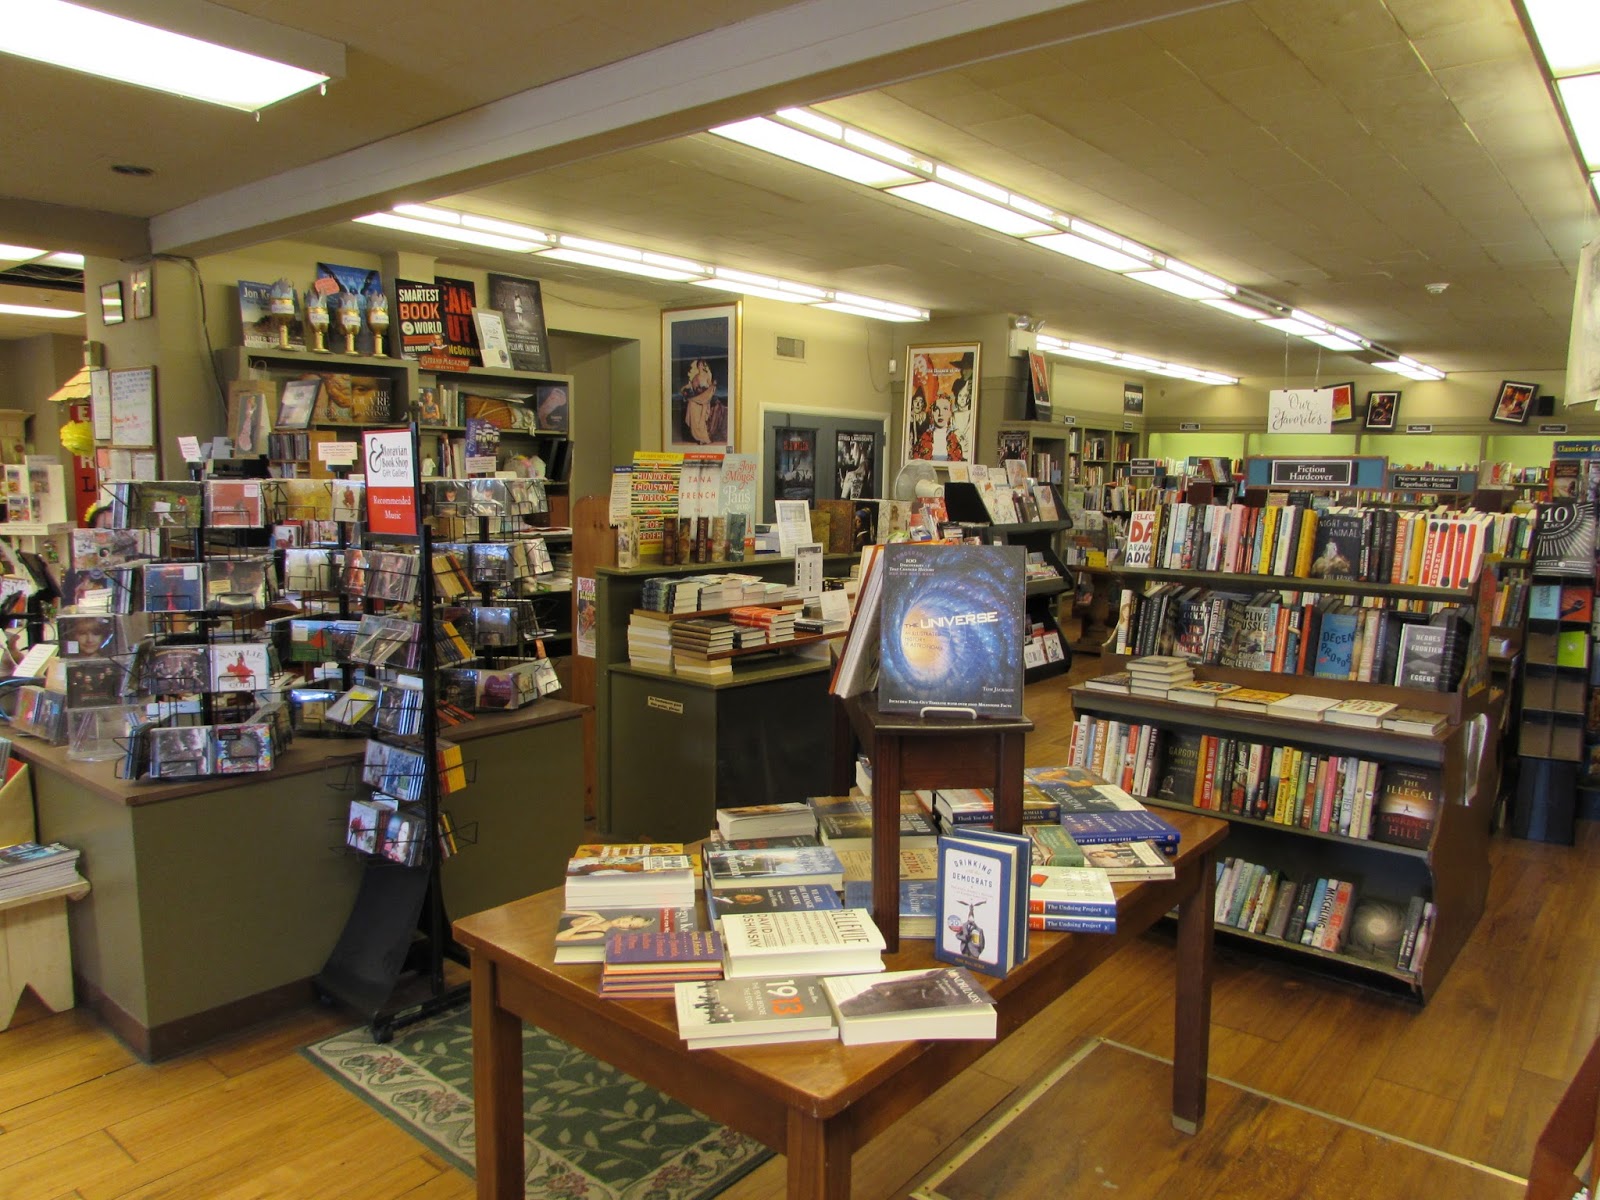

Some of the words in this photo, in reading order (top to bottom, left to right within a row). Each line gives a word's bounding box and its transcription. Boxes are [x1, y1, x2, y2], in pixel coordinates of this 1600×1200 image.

[243, 286, 258, 299] Jon
[399, 289, 439, 302] SMARTEST
[400, 303, 440, 319] BOOK
[414, 321, 443, 334] WORLD
[1288, 393, 1317, 411] Our
[1557, 444, 1588, 453] Classics
[1591, 443, 1600, 452] fo
[382, 459, 394, 468] Book
[395, 458, 409, 470] Shop
[738, 460, 757, 473] Jojo
[1297, 465, 1326, 474] Fiction
[382, 469, 391, 477] Gift
[637, 472, 672, 480] HUNDRED
[688, 475, 712, 483] TANA
[1289, 473, 1333, 481] Hardcover
[721, 470, 755, 490] Moyes
[633, 483, 674, 491] THOUSAND
[373, 495, 411, 505] Recommended
[637, 493, 669, 501] WORLDS
[681, 491, 716, 499] FRENCH
[723, 485, 751, 505] Paris
[384, 510, 401, 519] Music
[1319, 519, 1340, 528] NIGHT
[639, 532, 663, 540] PROEH
[1130, 520, 1153, 543] DA
[1329, 528, 1362, 538] ANIMALS
[1128, 543, 1151, 551] ARAV
[1425, 532, 1436, 571] MICHAEL
[1430, 553, 1441, 585] CHABON
[920, 611, 999, 629] UNIVERSE
[1244, 611, 1269, 621] CLIVE
[1241, 620, 1269, 632] USSLE
[1322, 631, 1355, 645] DECEN
[1416, 634, 1441, 642] HEROES
[1320, 642, 1352, 667] PROPOS
[1411, 645, 1443, 654] FRONTIER
[229, 681, 254, 689] COLE
[1410, 674, 1436, 683] EGGERS
[1079, 728, 1086, 742] AM
[1097, 722, 1105, 743] HERE
[1077, 744, 1084, 755] NO
[1093, 752, 1100, 766] AM
[1403, 779, 1419, 787] THE
[1387, 784, 1433, 800] ILLEGAL
[1343, 798, 1352, 812] HEX
[1388, 825, 1421, 840] HILL
[900, 851, 924, 874] CRIME
[954, 859, 992, 875] DRINKING
[952, 872, 993, 888] DEMOCRATS
[792, 895, 801, 905] SEEK
[802, 892, 815, 909] CHANGE
[1059, 904, 1081, 912] Undoing
[1082, 906, 1101, 914] Project
[1317, 887, 1335, 929] MISCHLING
[757, 914, 772, 933] DAVID
[831, 909, 870, 944] BELLEVUE
[1059, 921, 1081, 929] Undoing
[743, 914, 764, 948] OSHINSKY
